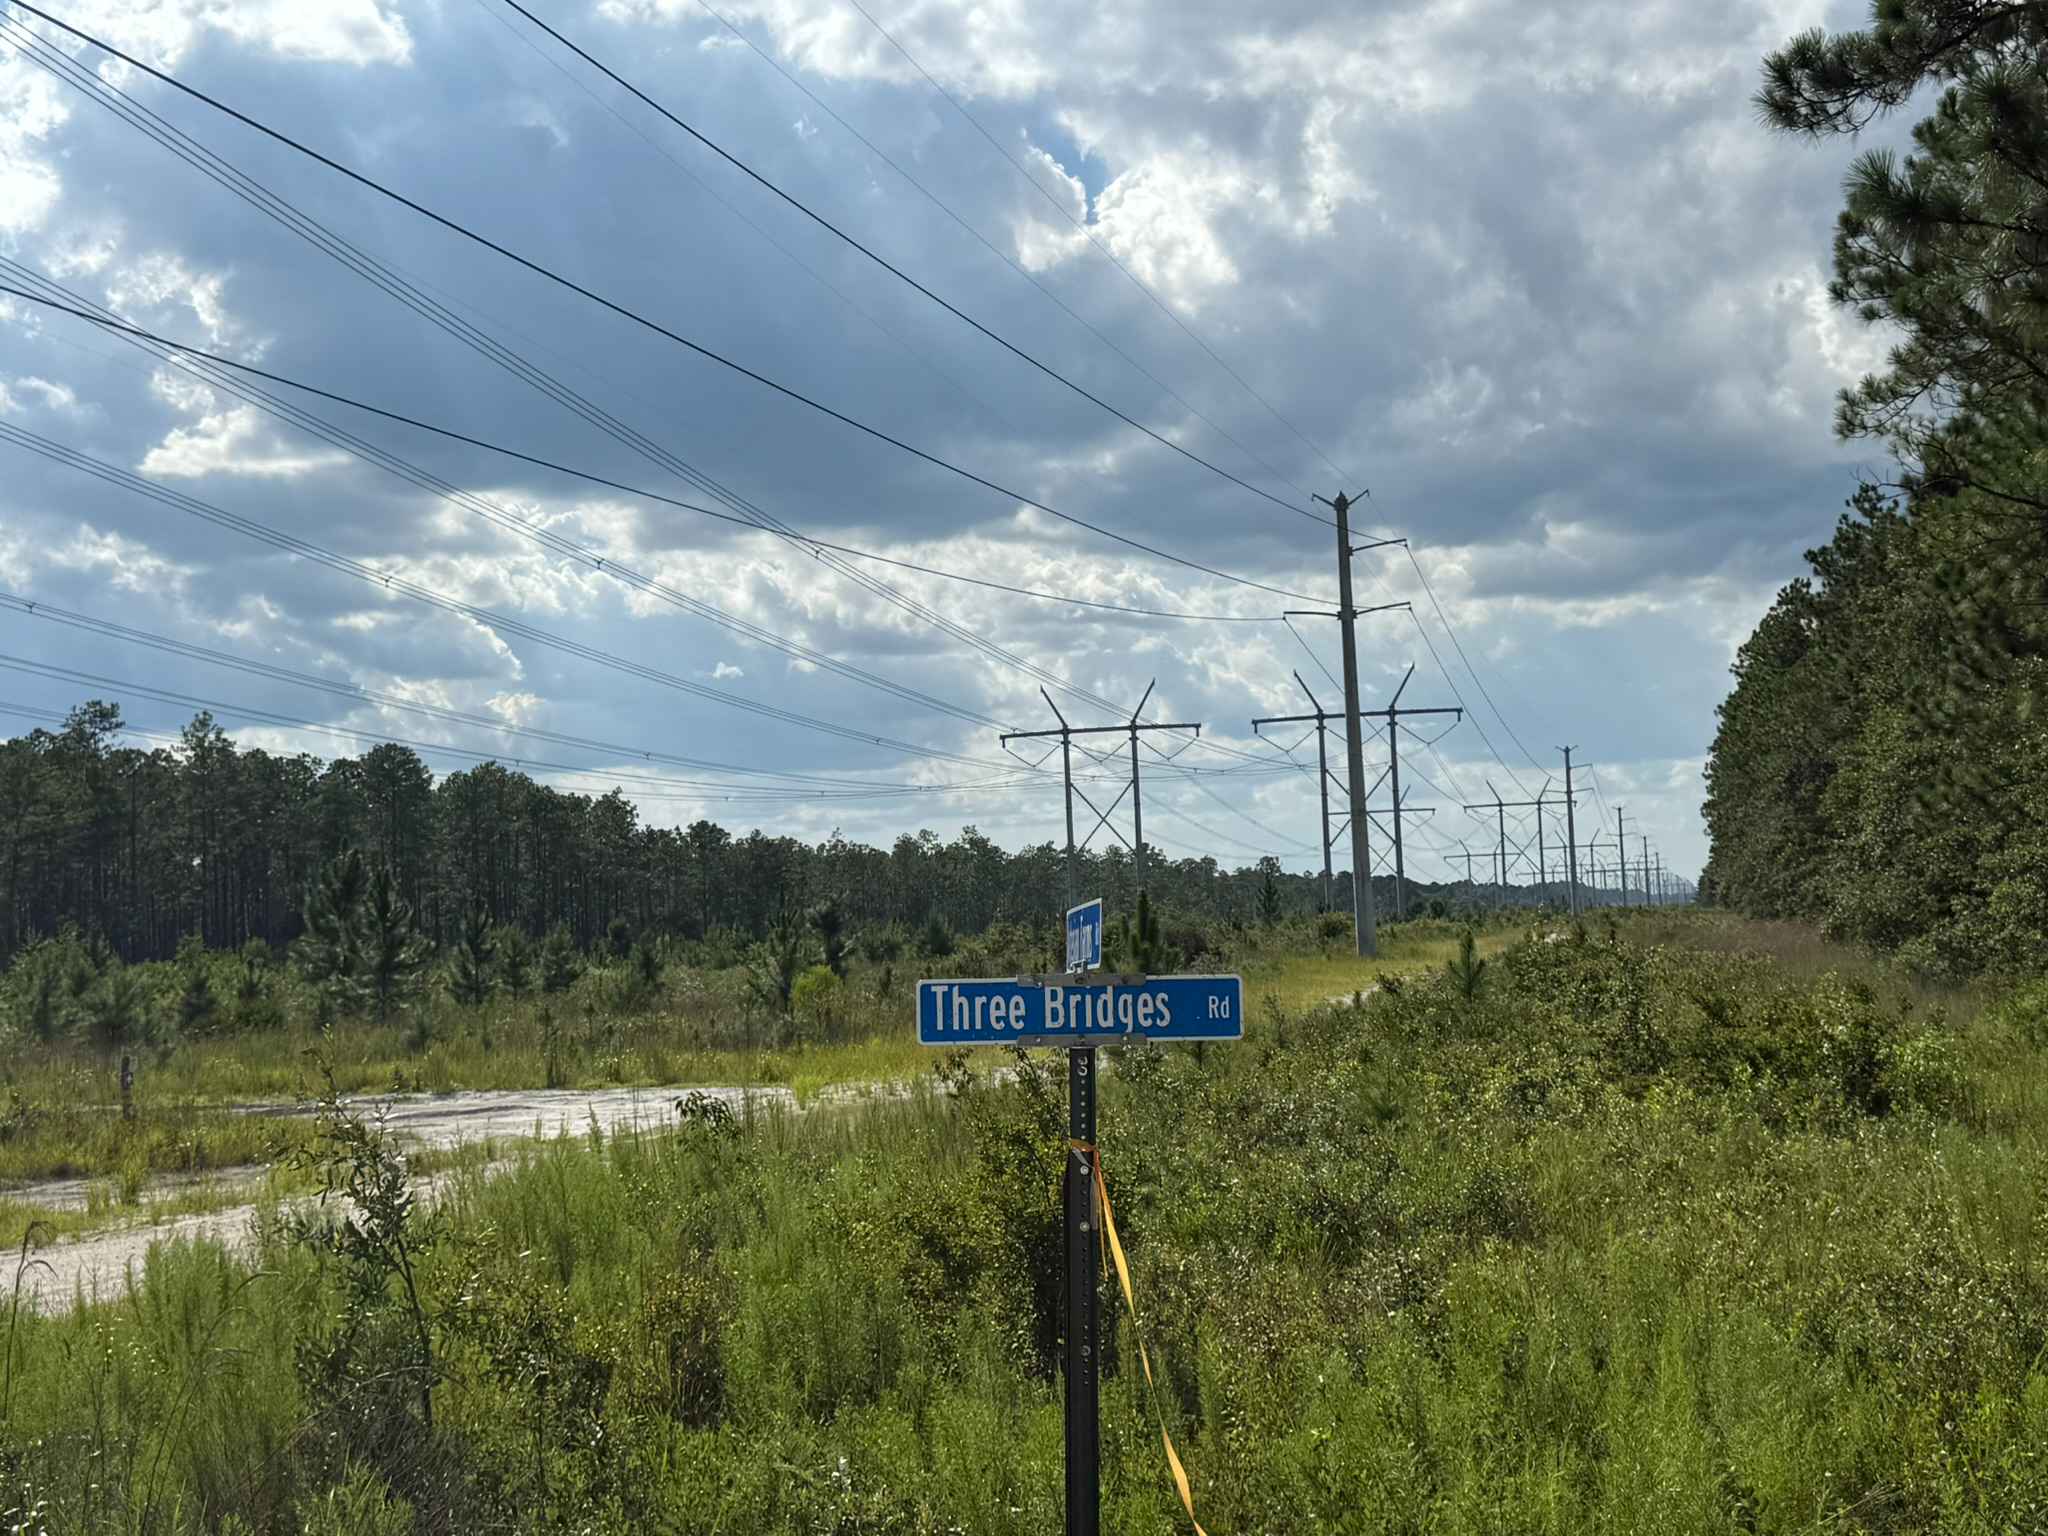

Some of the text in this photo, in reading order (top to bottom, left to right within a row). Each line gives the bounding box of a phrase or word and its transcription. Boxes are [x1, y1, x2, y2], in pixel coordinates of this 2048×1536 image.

[931, 985, 1230, 1033] Three Bridges Rd
